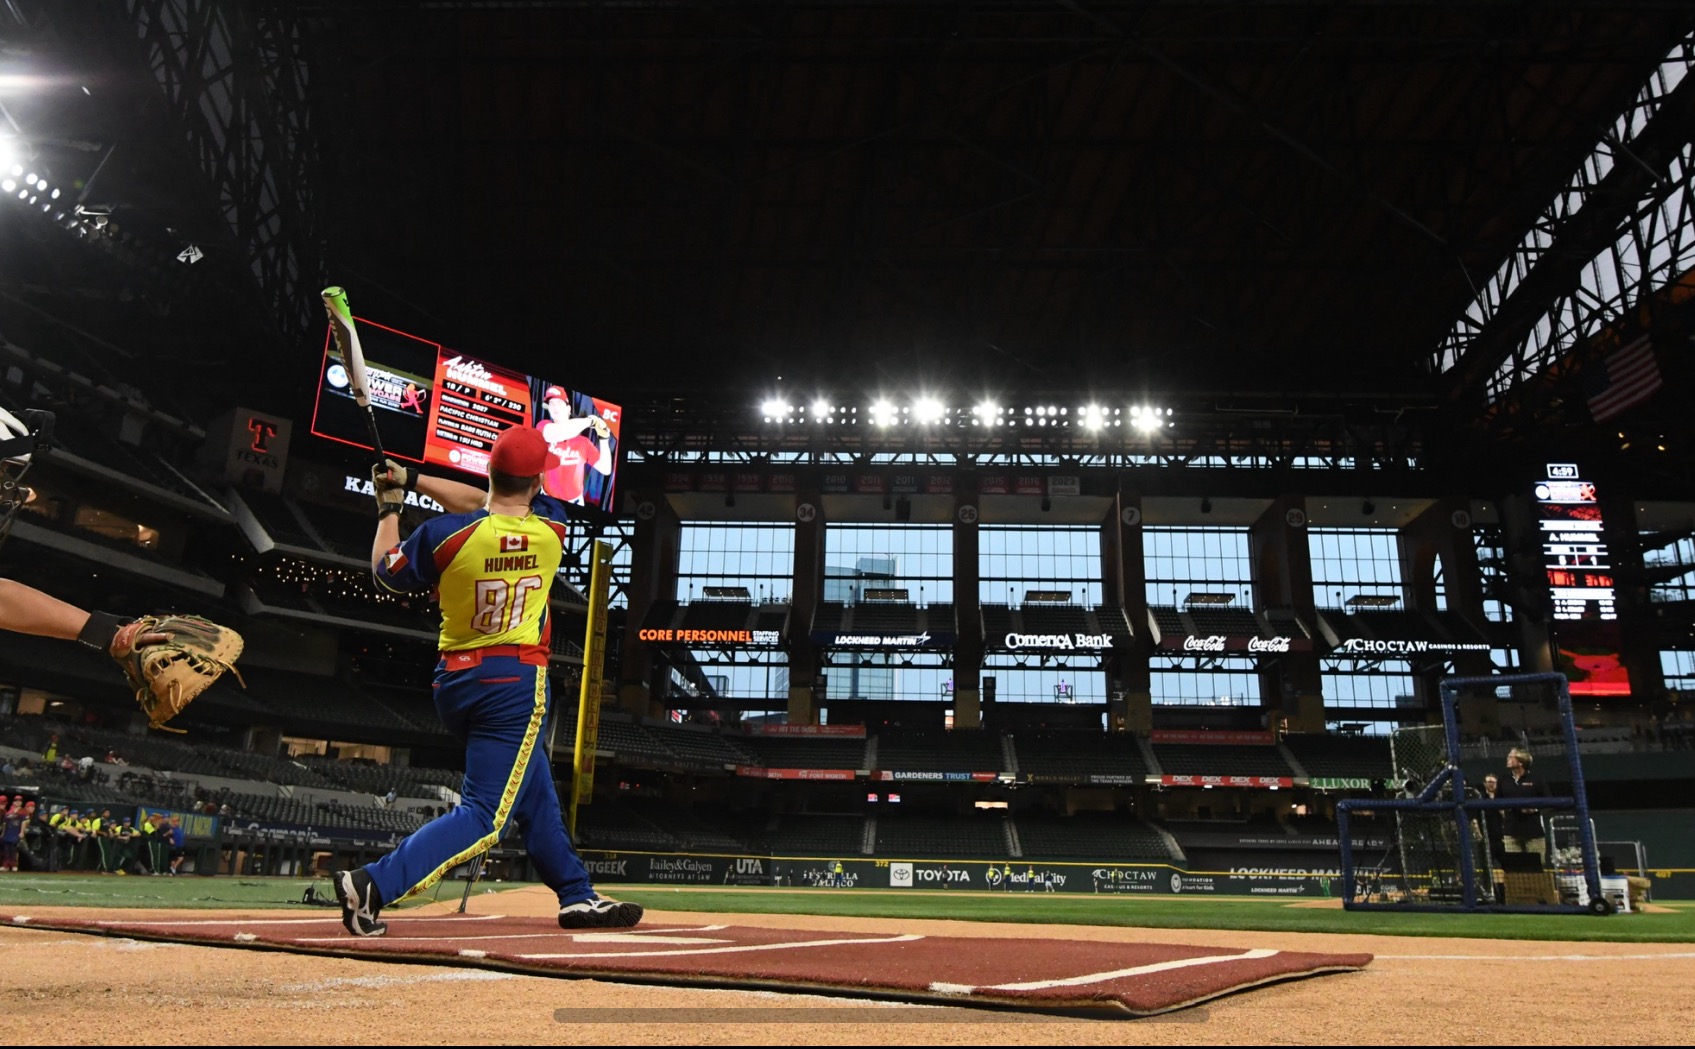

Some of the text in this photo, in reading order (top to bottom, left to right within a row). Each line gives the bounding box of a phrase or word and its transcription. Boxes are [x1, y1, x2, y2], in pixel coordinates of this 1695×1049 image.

[440, 405, 465, 418] PACIFIC
[602, 408, 618, 422] BC
[236, 449, 278, 470] TEXAS
[960, 508, 976, 520] 26
[484, 554, 539, 573] HUMMEL
[640, 629, 752, 642] CORE PERSONNEL
[835, 635, 917, 646] LOCKHEED MARTIN
[1075, 633, 1113, 649] Bank
[1352, 639, 1428, 652] CHOCTAW
[894, 771, 943, 780] GARDENERS
[944, 772, 971, 780] TRUST
[1322, 778, 1370, 789] LUXOR
[582, 859, 627, 876] ATGEEK
[735, 858, 763, 874] UTA
[1229, 867, 1308, 881] LOCKHEED
[1278, 887, 1298, 895] MARTIN
